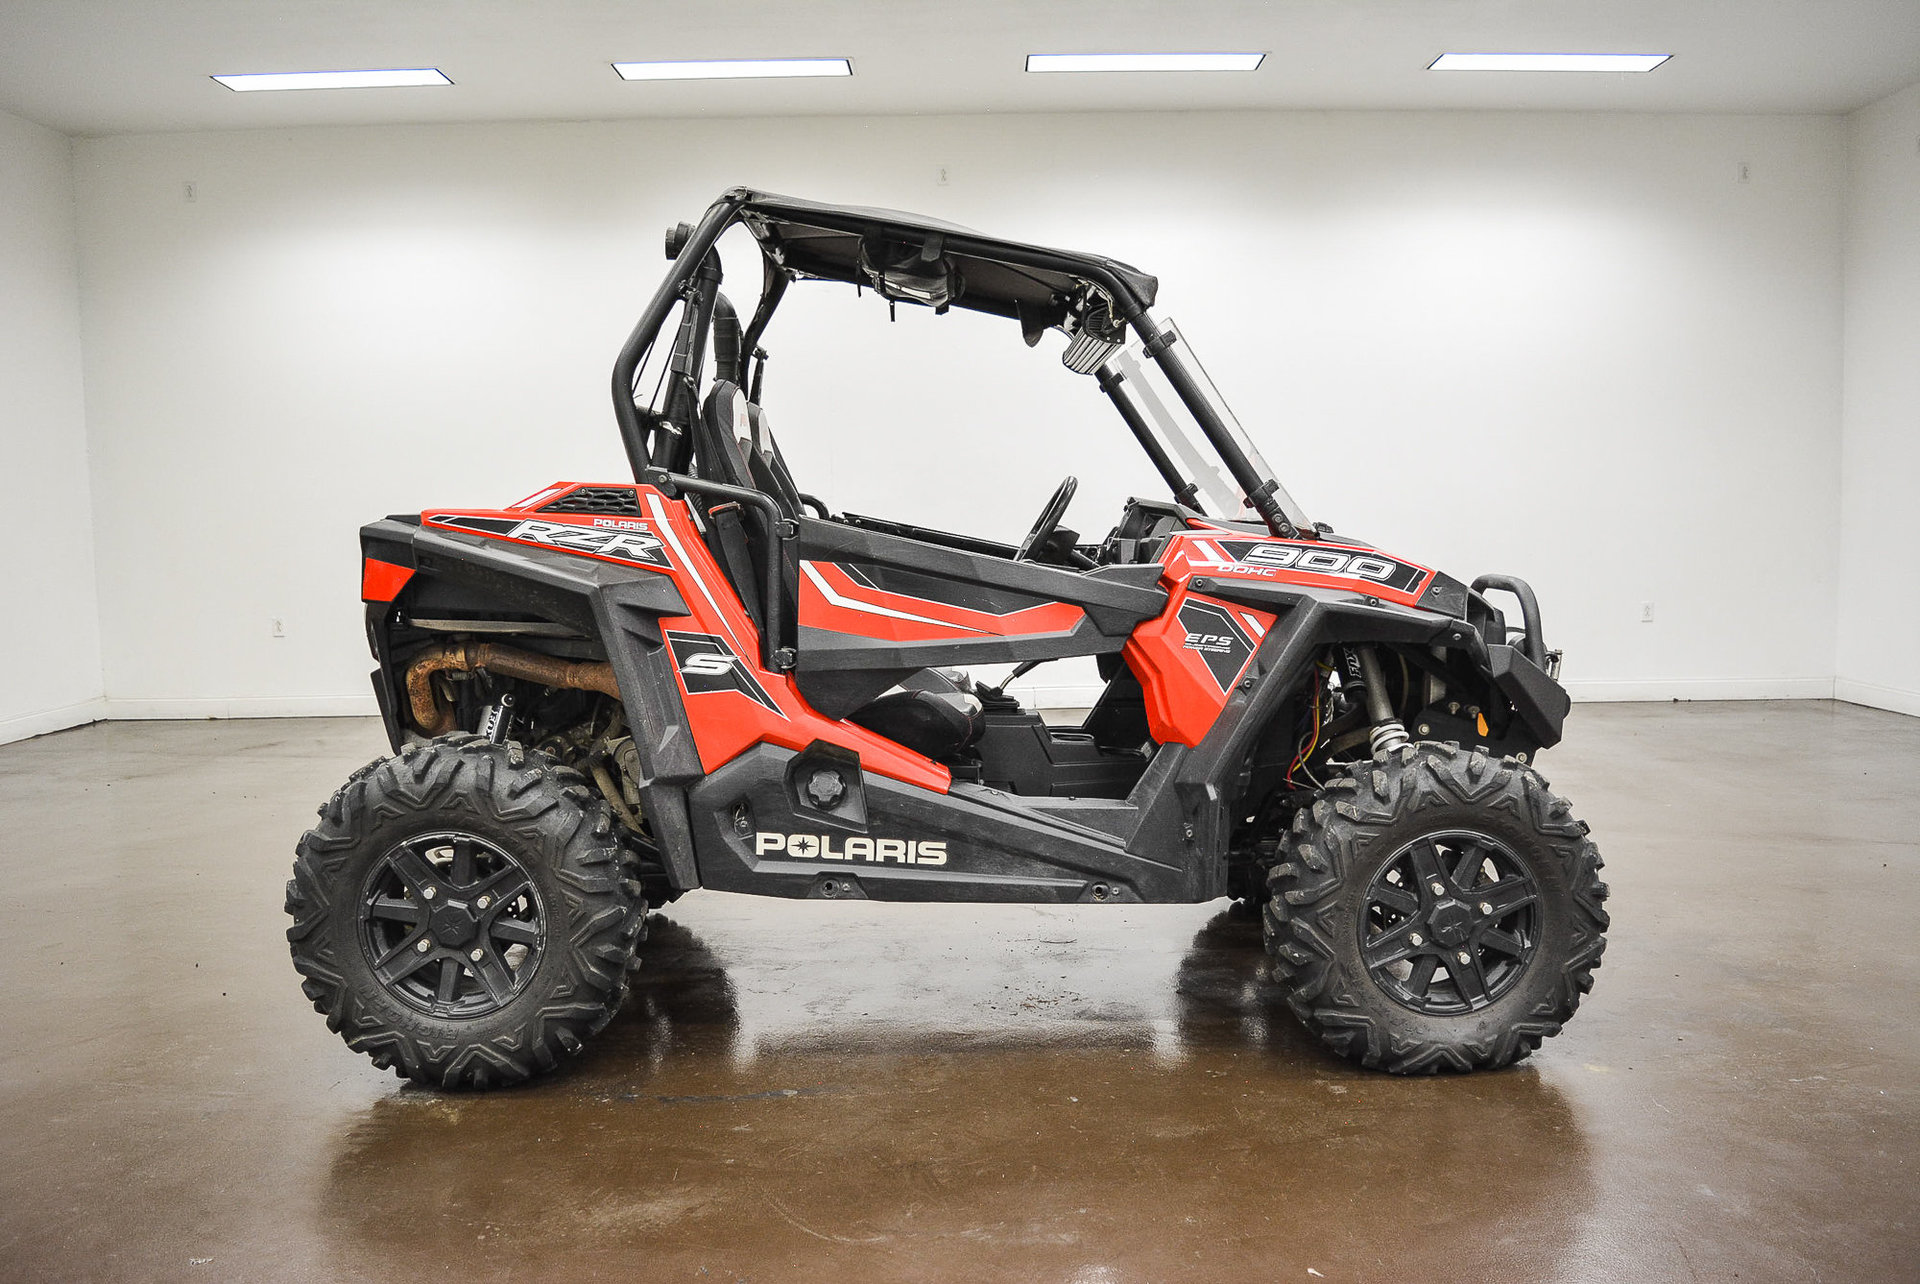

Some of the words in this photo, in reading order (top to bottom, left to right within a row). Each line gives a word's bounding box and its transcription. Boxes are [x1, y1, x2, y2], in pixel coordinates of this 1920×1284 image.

[593, 518, 649, 531] POLARIS
[506, 518, 666, 562] RZR
[1217, 565, 1277, 577] DOHC
[1241, 543, 1397, 581] 900
[1184, 632, 1234, 646] EPS
[677, 653, 741, 676] S
[755, 831, 948, 866] POLARIS
